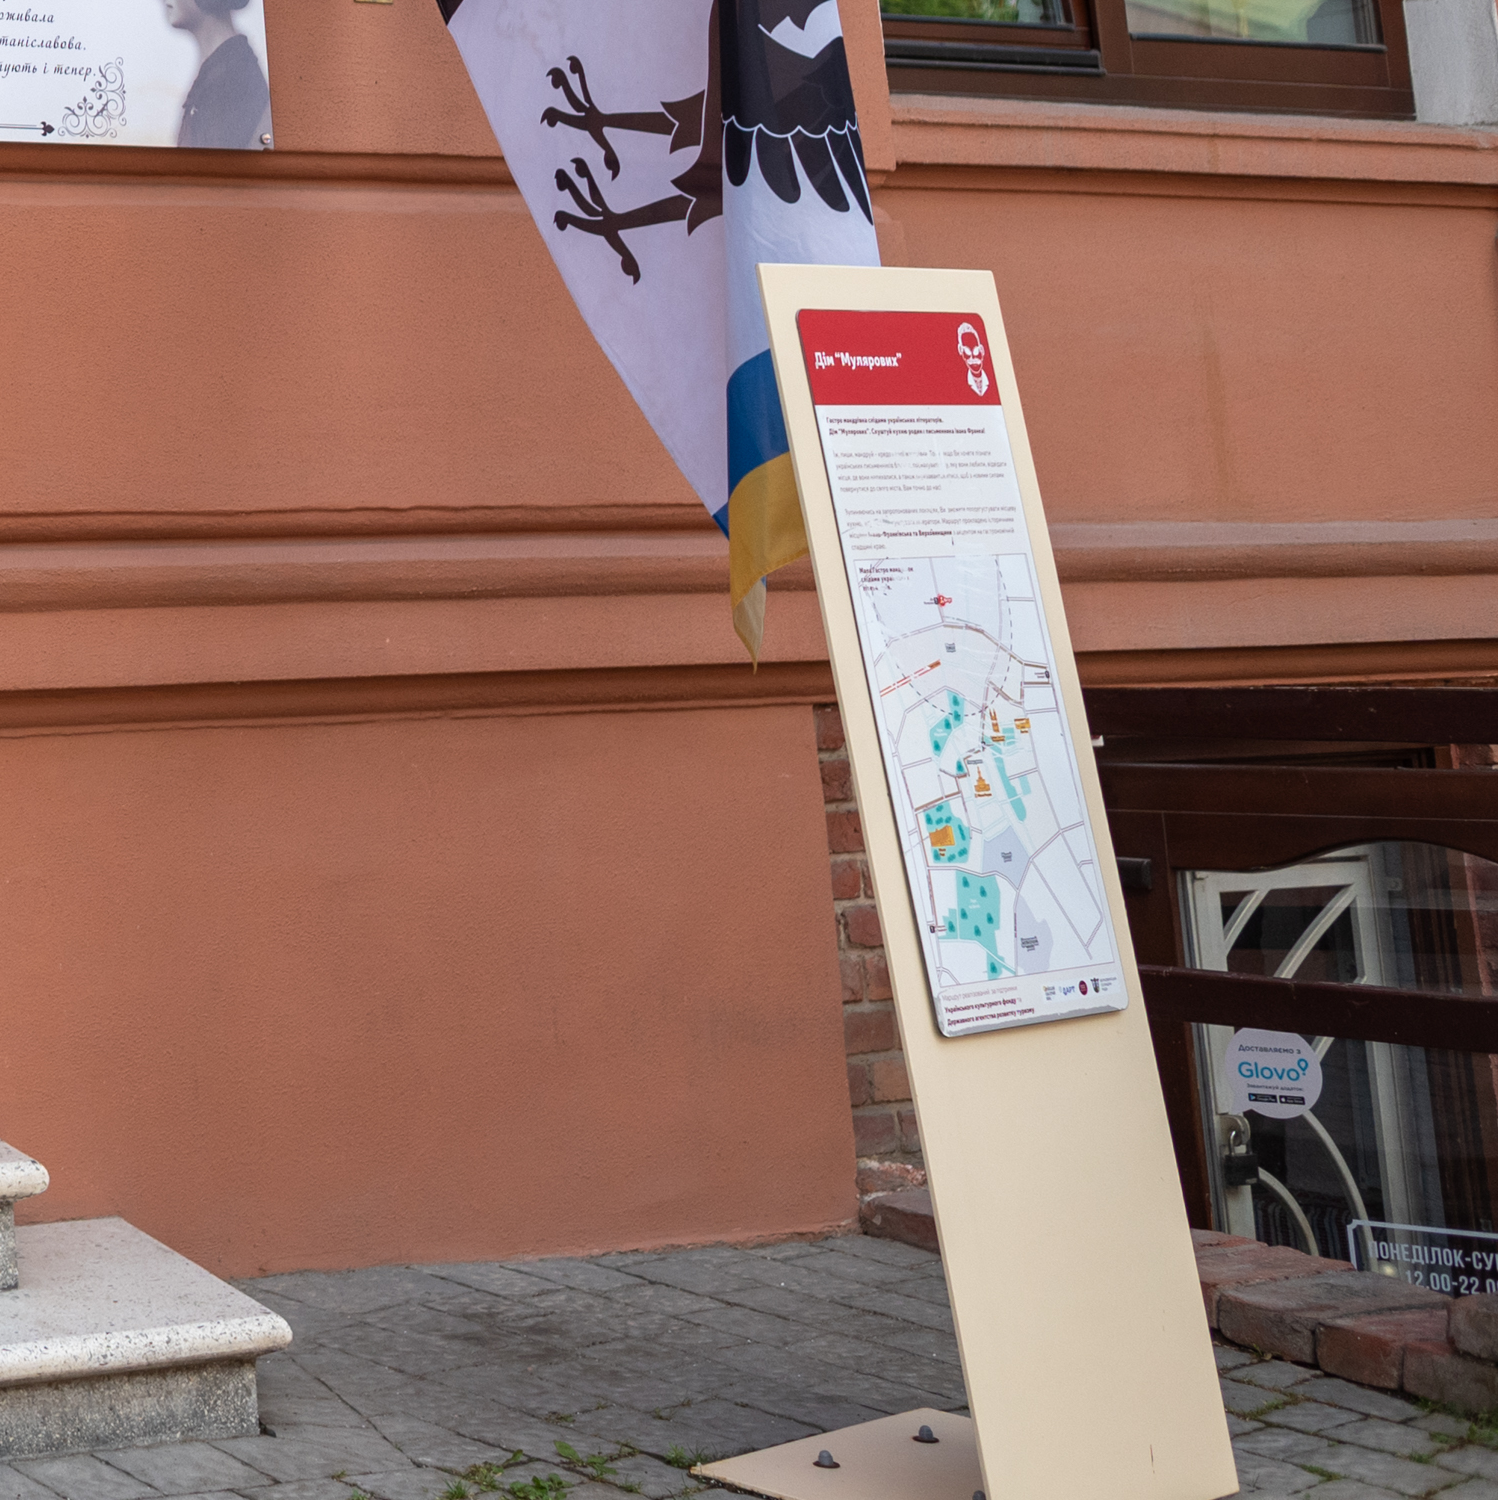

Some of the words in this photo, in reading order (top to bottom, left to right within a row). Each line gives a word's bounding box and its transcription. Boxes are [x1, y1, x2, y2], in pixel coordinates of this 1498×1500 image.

[43, 62, 48, 74] і
[53, 63, 96, 82] тепер.
[814, 352, 835, 369] Дім
[1237, 1061, 1300, 1082] Glovo
